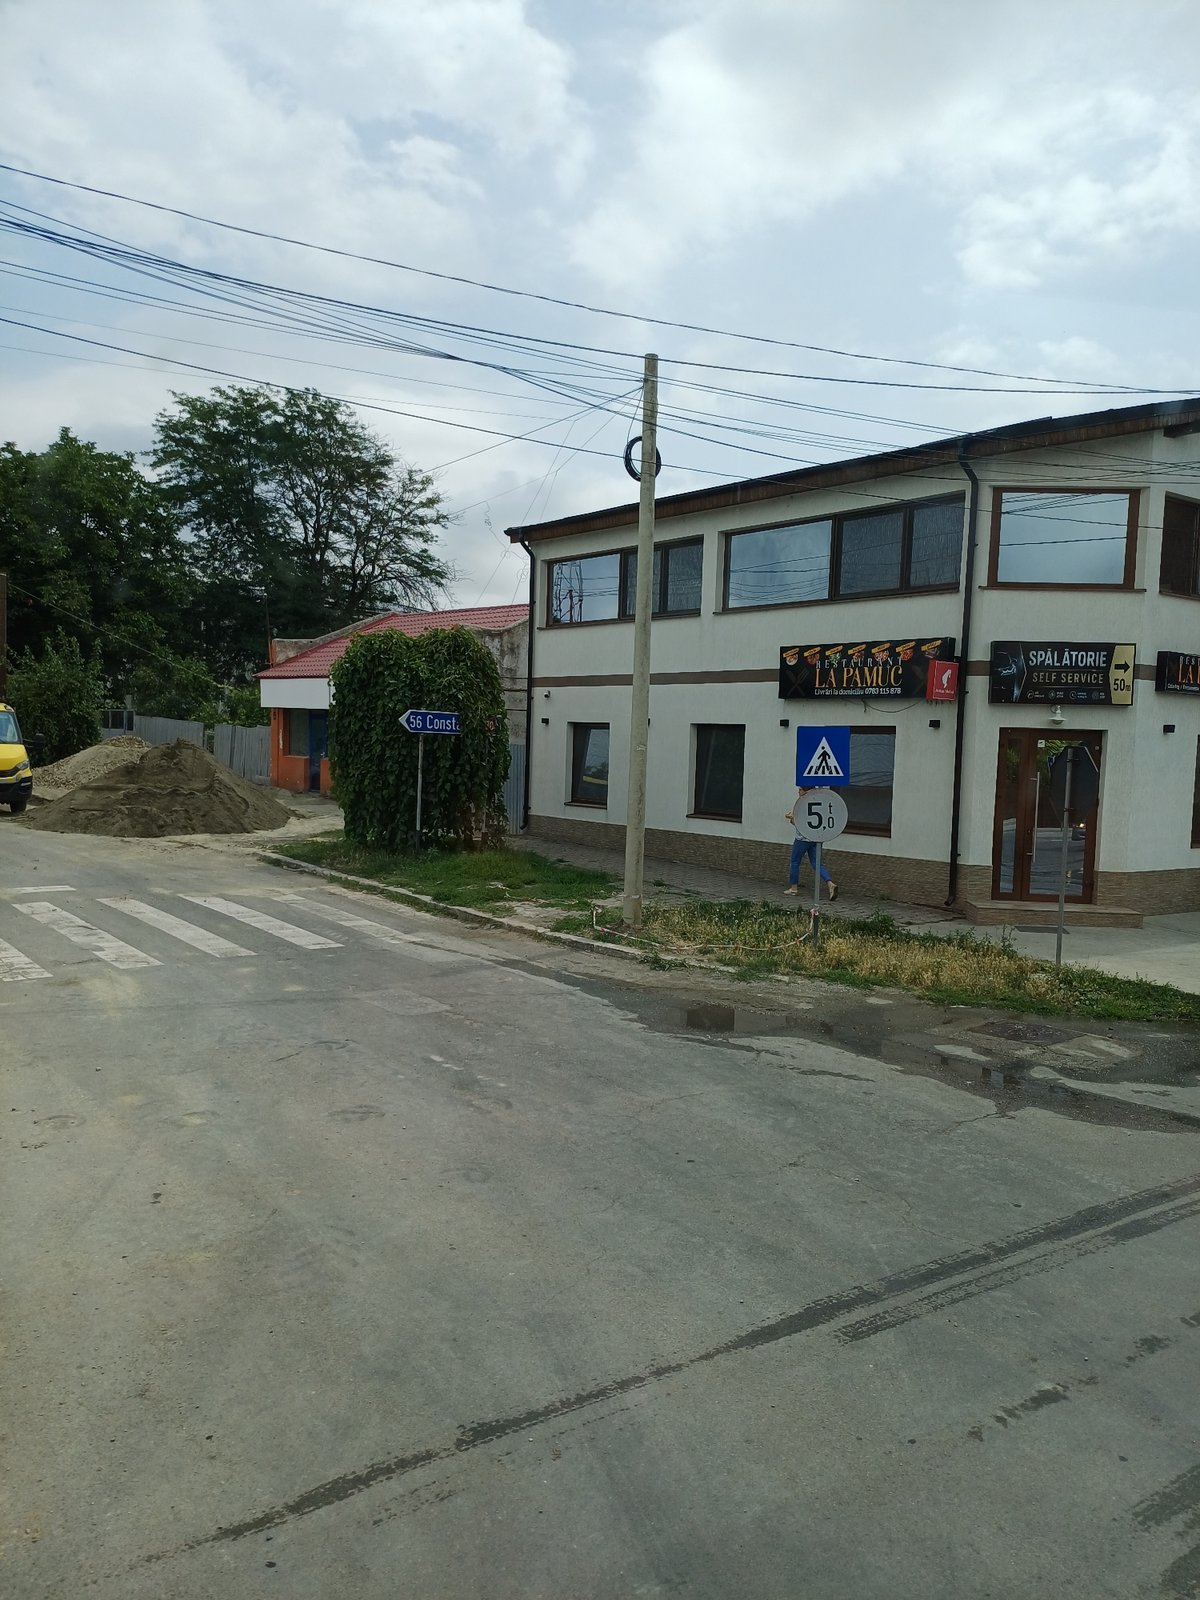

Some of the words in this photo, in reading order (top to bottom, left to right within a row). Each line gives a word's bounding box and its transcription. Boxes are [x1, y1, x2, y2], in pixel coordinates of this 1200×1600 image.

[815, 668, 837, 688] LA
[843, 665, 903, 688] PAMUC
[1032, 672, 1057, 683] SELF
[1060, 672, 1104, 684] SERVICE
[879, 687, 890, 695] 115
[409, 715, 423, 728] 56
